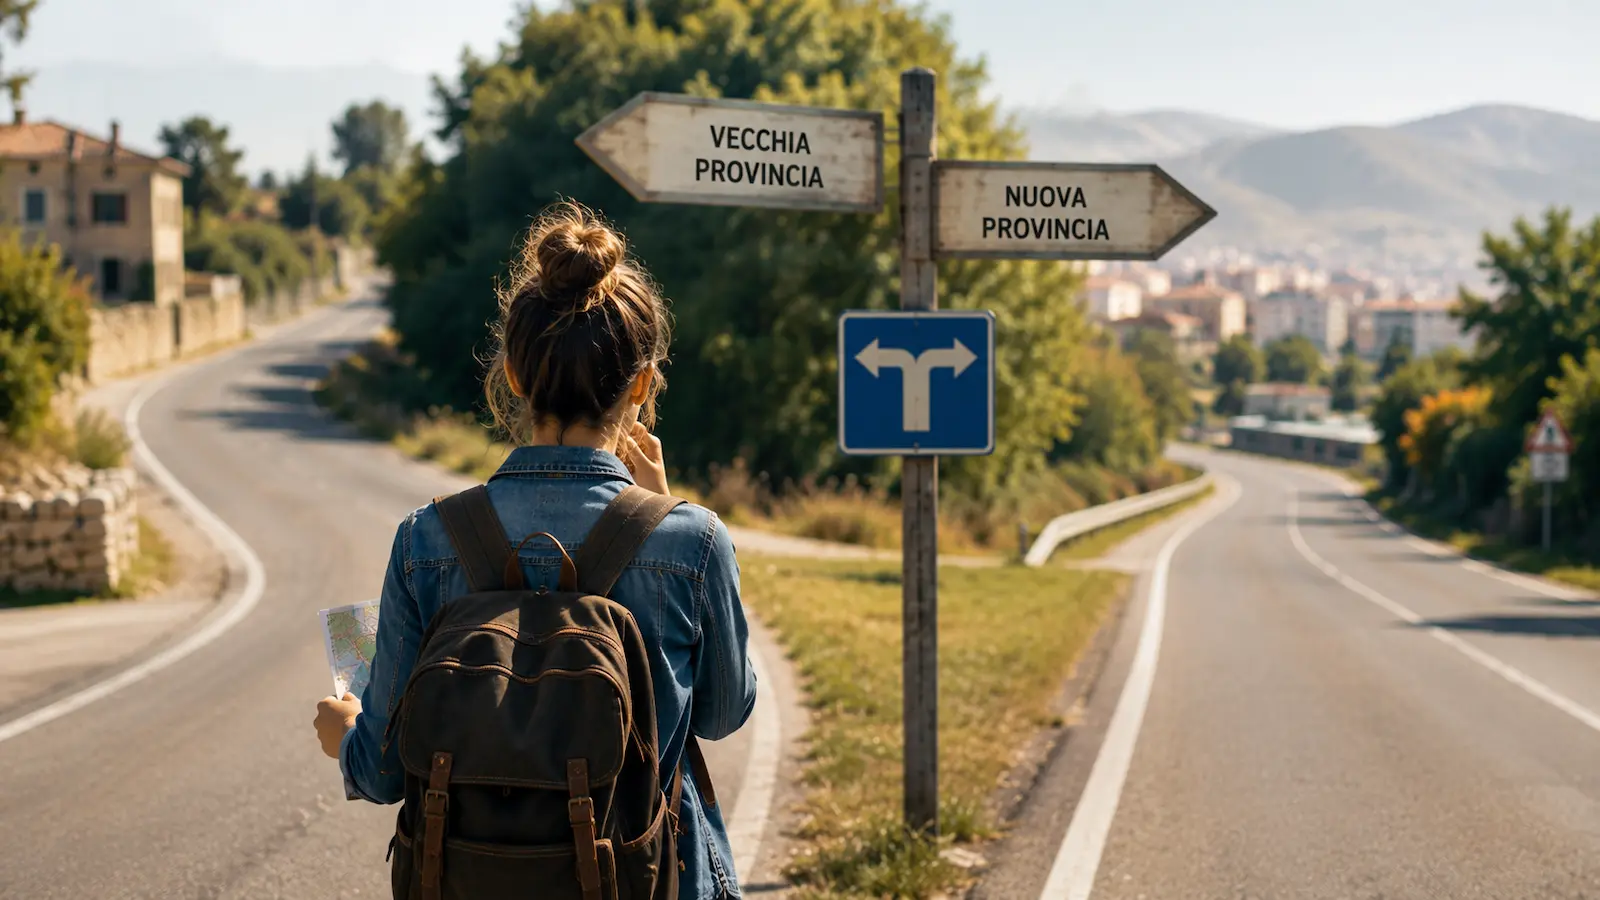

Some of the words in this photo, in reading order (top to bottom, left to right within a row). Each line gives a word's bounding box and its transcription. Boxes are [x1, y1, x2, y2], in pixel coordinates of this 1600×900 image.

[710, 125, 810, 155] VECCHIA
[695, 159, 824, 189] PROVINCIA
[1005, 185, 1087, 209] NUOVA
[982, 217, 1110, 241] PROVINCIA
